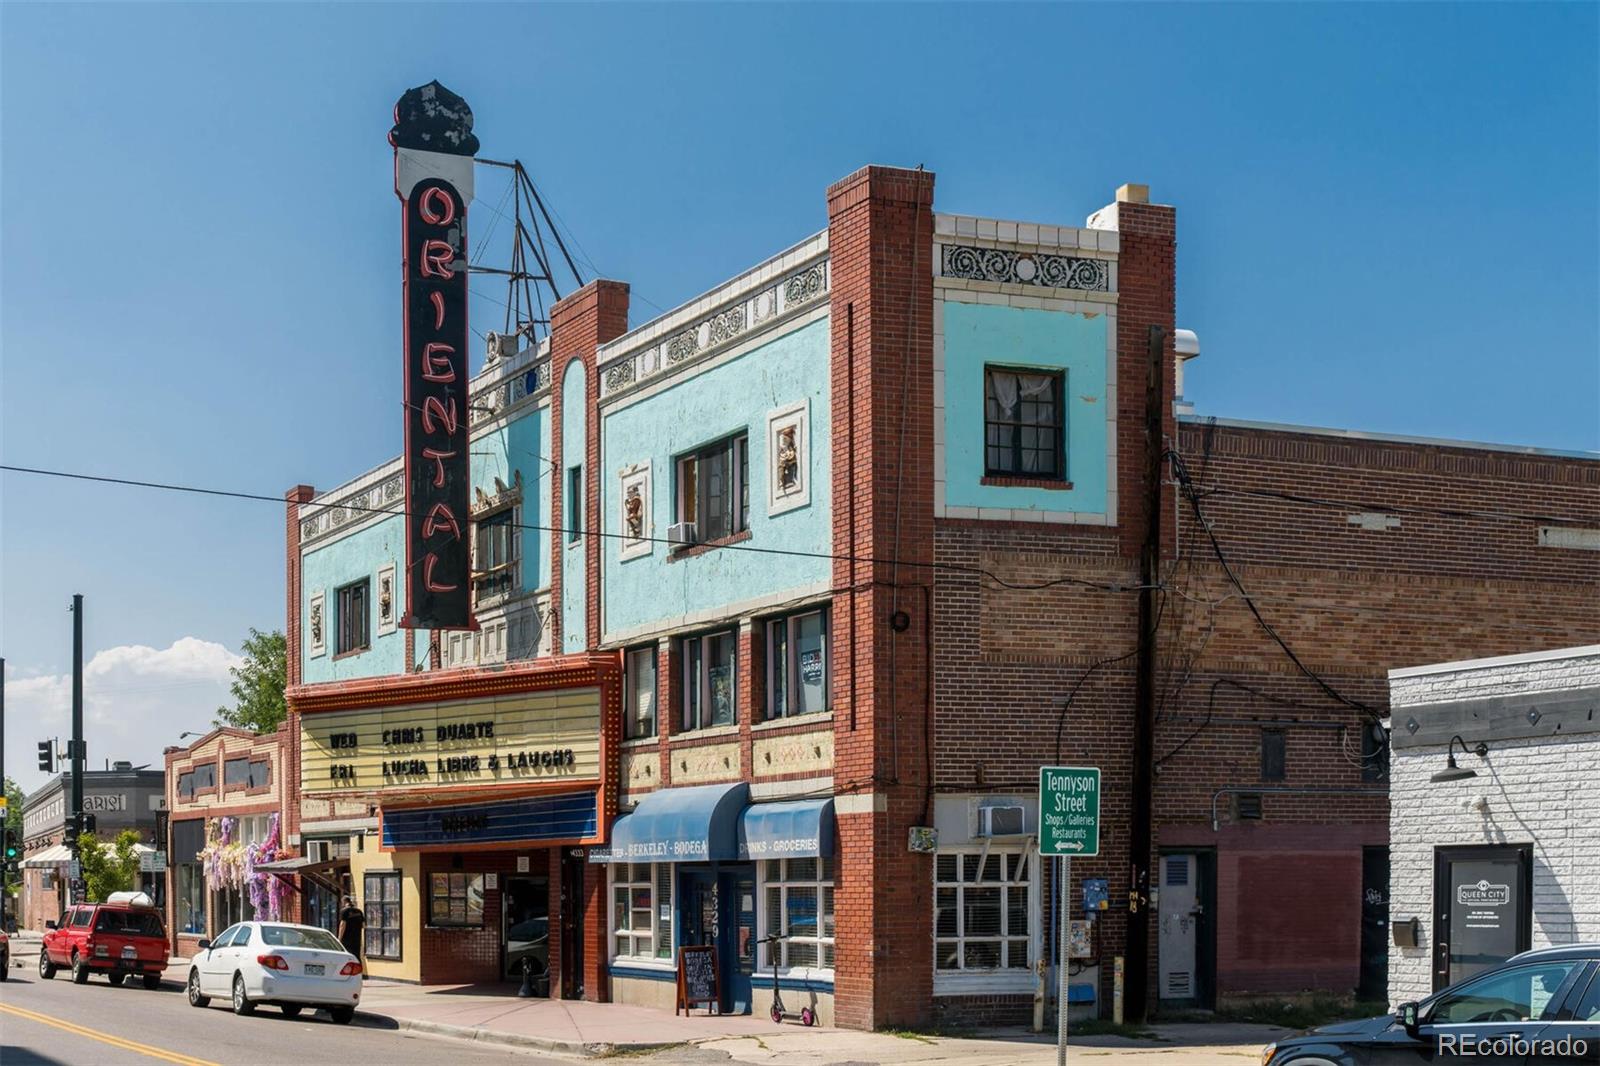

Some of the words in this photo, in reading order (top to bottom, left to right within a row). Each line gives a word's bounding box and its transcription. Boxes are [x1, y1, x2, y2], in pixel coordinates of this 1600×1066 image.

[418, 186, 461, 593] ORIENTAL
[330, 733, 357, 749] WED
[383, 727, 424, 745] CHRIS
[436, 721, 494, 742] DUARTE
[330, 763, 355, 779] FRI
[382, 760, 428, 776] LUCHA
[437, 754, 479, 773] LIBRE
[487, 754, 498, 771] &
[508, 749, 574, 769] LAUGHS
[1046, 772, 1095, 795] Tennyson
[1054, 792, 1087, 812] Street
[1051, 826, 1087, 839] Restaurants
[628, 840, 669, 857] BERKELEY
[673, 839, 708, 855] BODEGA
[738, 841, 767, 855] DRINKS
[773, 838, 819, 853] GROCERIES
[1461, 891, 1487, 899] QUEEN
[711, 881, 720, 938] 4329
